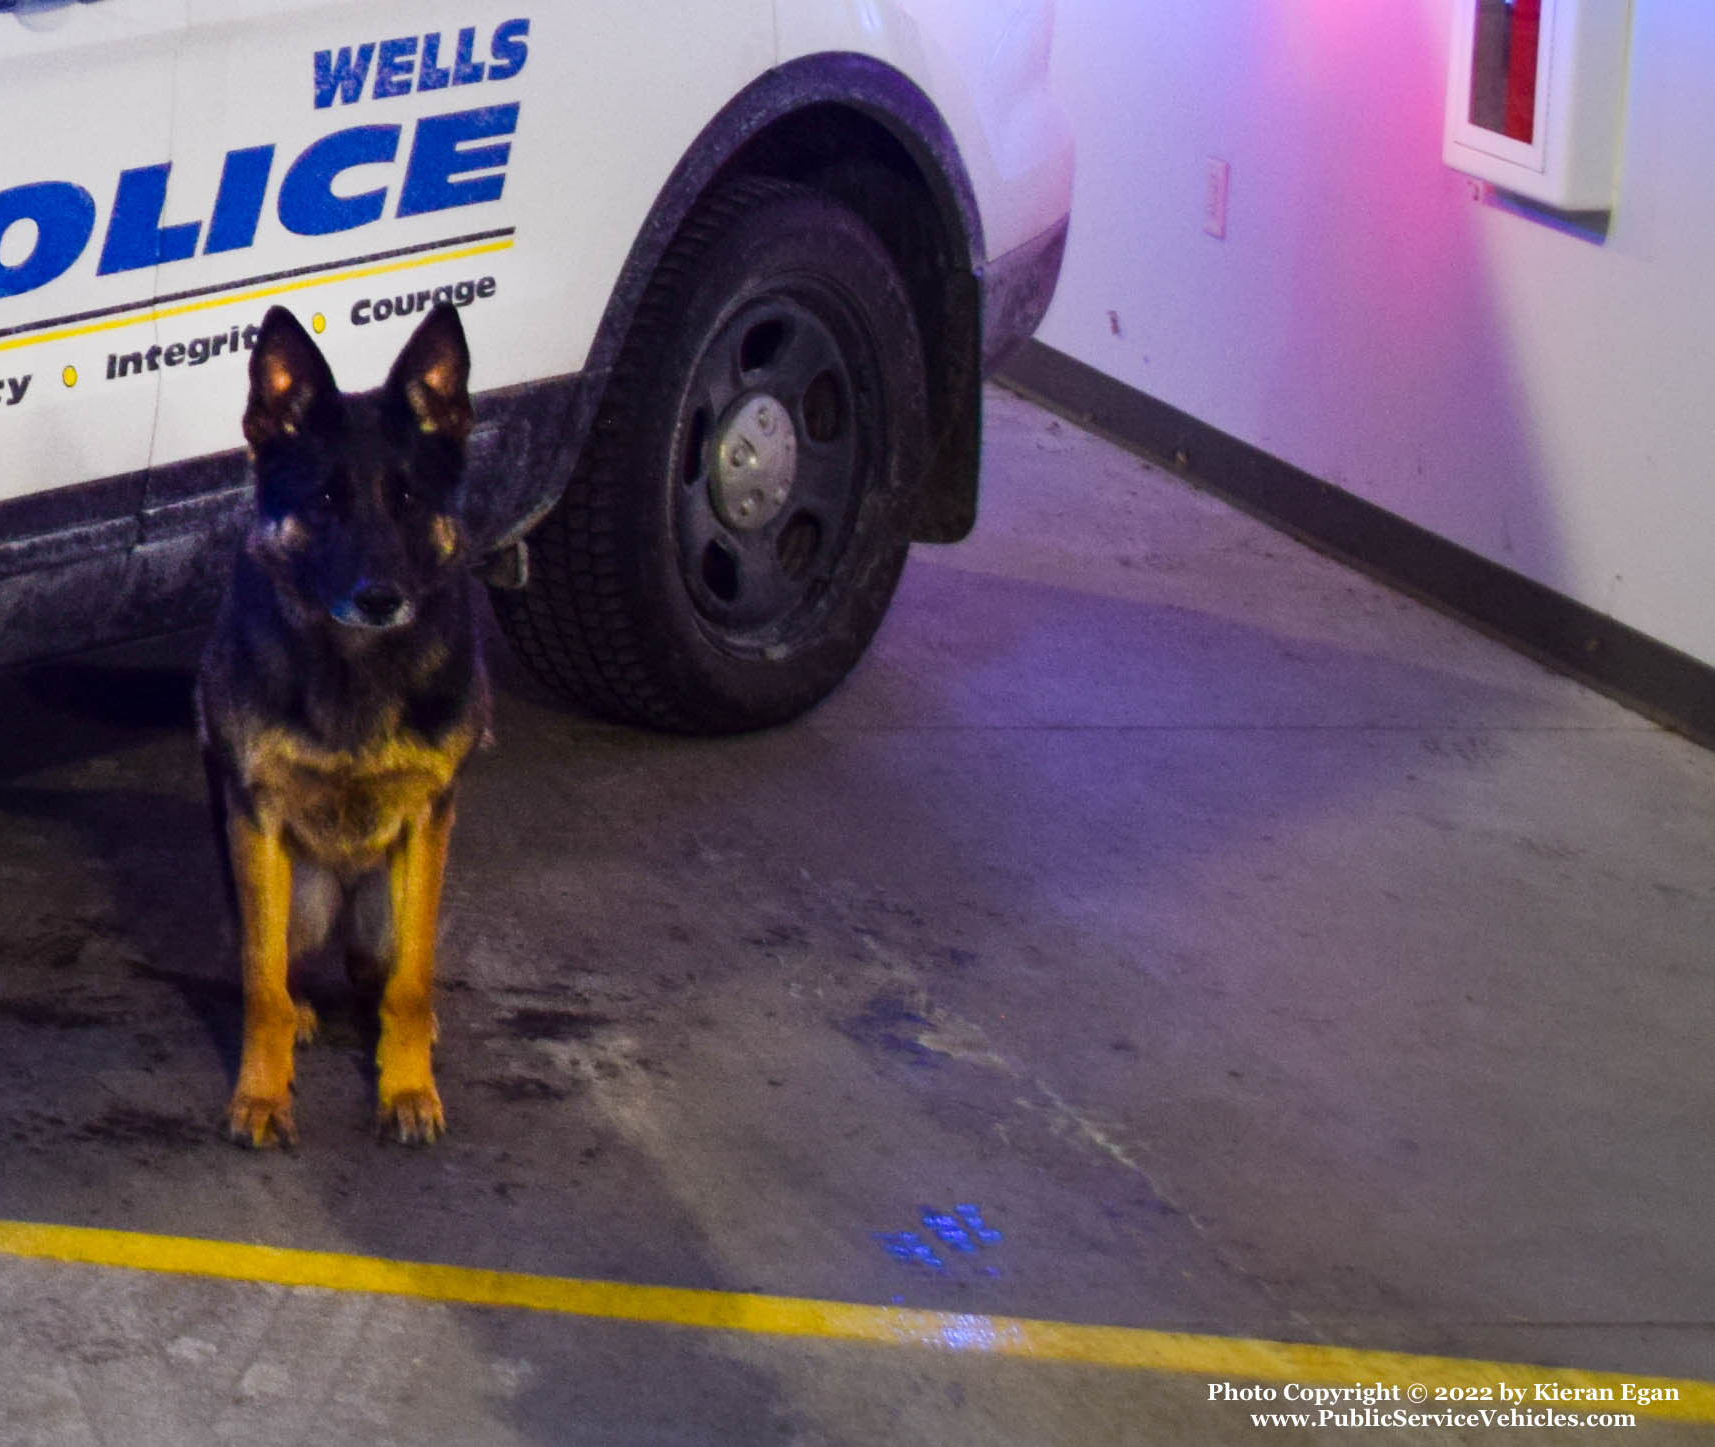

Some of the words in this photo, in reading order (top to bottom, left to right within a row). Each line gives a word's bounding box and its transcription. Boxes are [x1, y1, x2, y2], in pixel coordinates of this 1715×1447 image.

[313, 18, 531, 110] WELLS
[106, 324, 264, 380] Integrit
[350, 275, 497, 326] Courage
